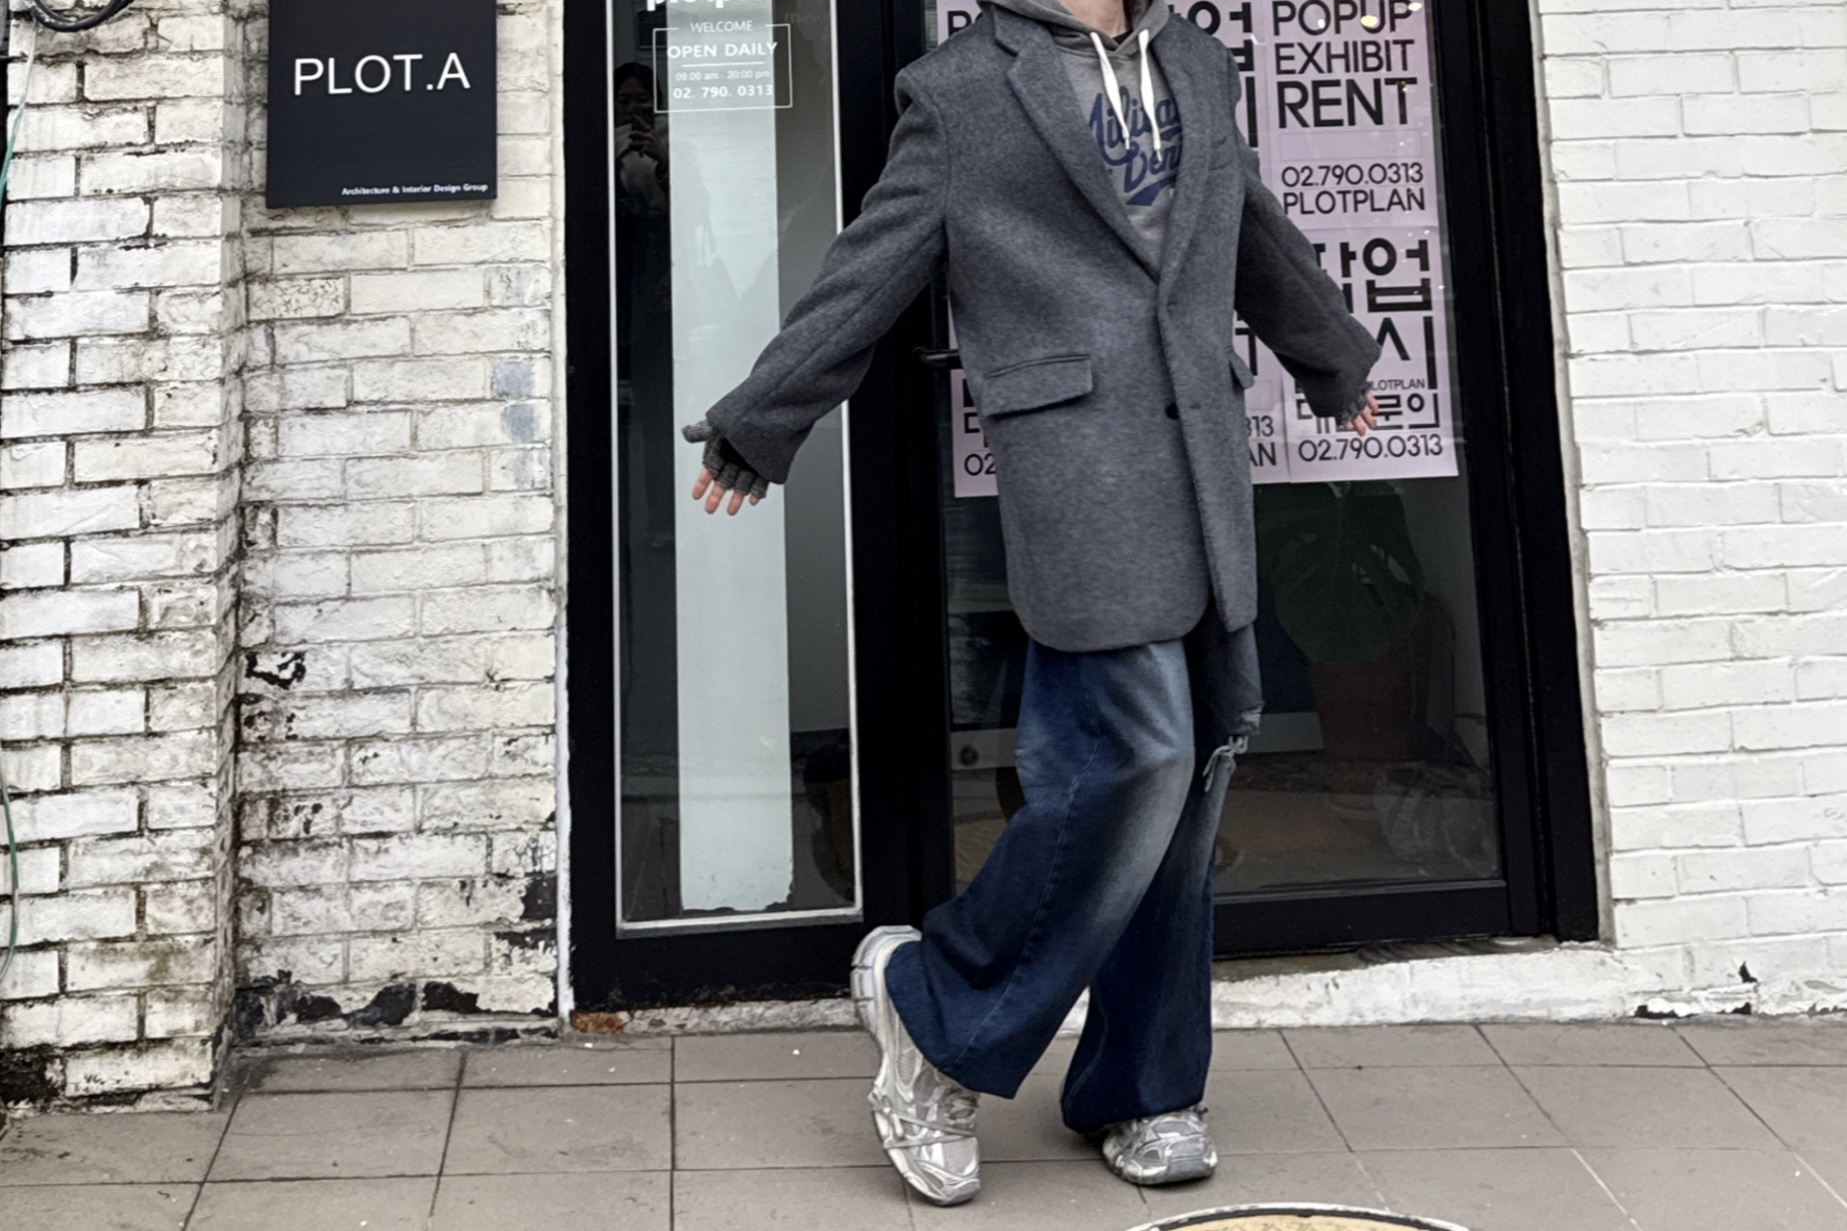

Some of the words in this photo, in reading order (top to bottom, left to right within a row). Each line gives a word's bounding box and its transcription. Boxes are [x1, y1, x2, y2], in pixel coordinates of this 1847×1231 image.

[689, 19, 754, 33] WELCOME
[667, 44, 718, 59] OPEN
[724, 41, 778, 58] DAILY
[1274, 39, 1415, 75] EXHIBIT
[294, 52, 471, 96] PLOT.A
[737, 84, 774, 97] 0313
[1276, 77, 1418, 129] RENT
[1281, 162, 1424, 188] 02.790.0313
[341, 186, 390, 196] Architecture
[402, 184, 432, 193] Interior
[433, 183, 461, 194] Design
[463, 183, 488, 193] Group
[1283, 188, 1426, 215] PLOTPLAN
[1370, 378, 1425, 391] LOTPLAN
[1298, 433, 1443, 462] 02.790.0313
